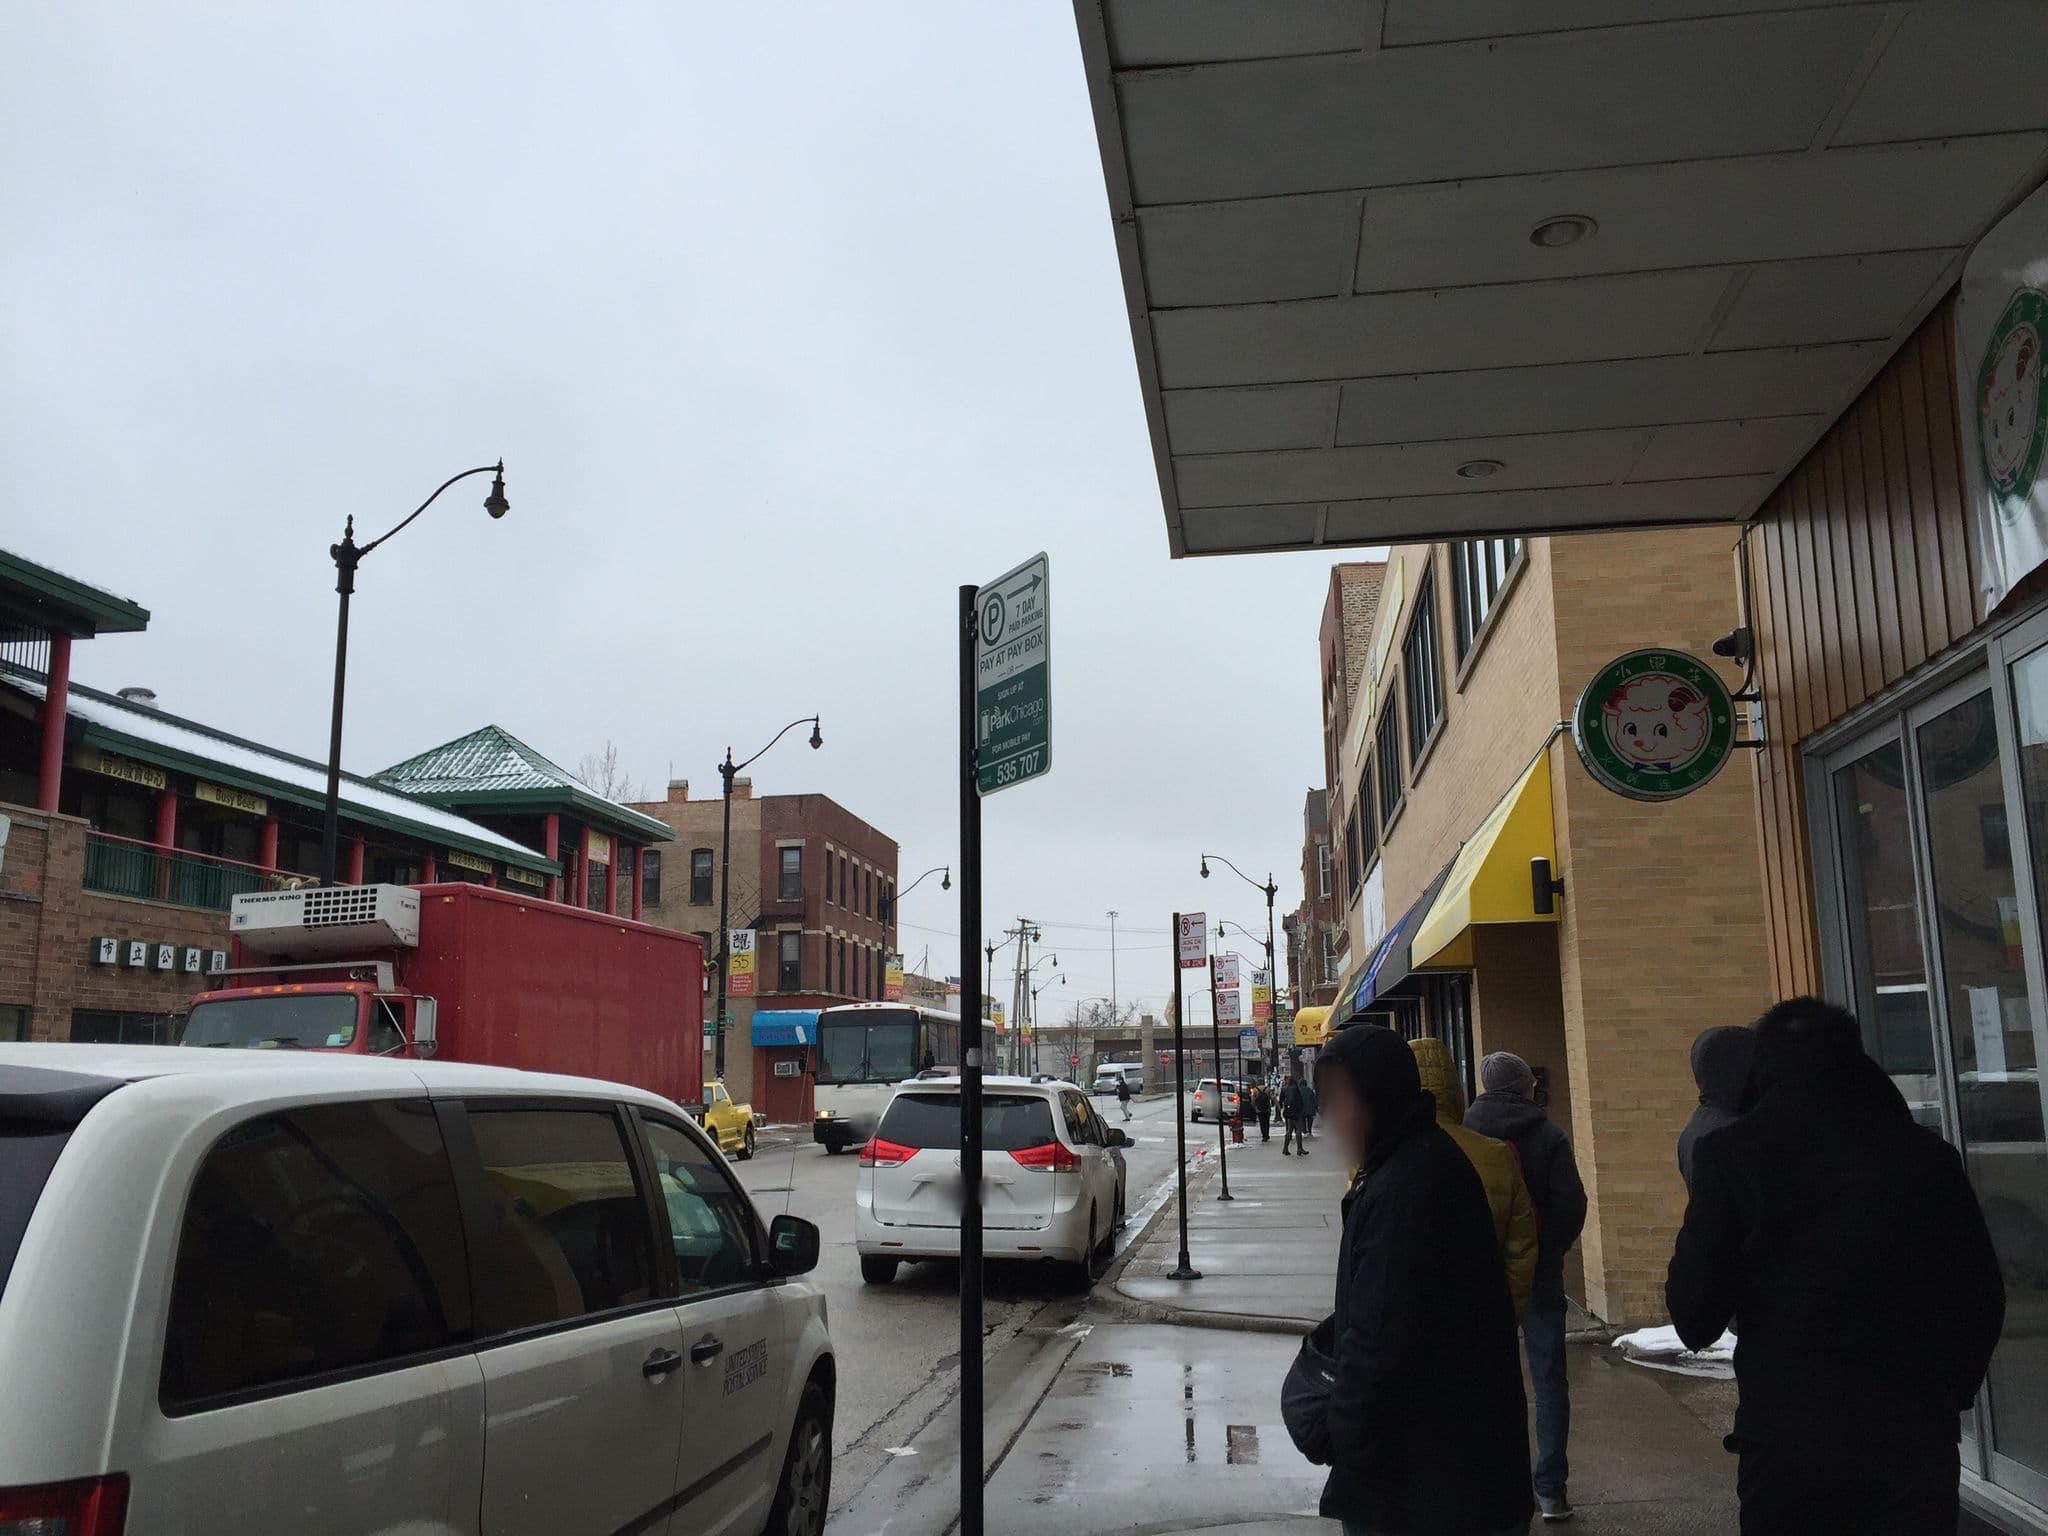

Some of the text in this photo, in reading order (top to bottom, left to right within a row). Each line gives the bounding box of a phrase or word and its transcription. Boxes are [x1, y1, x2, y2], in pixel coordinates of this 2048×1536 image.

[1015, 595, 1036, 619] 7 DAY
[1008, 607, 1044, 634] PAID PARKING
[980, 631, 1044, 675] PAY AT PAY BOX
[990, 698, 1045, 732] ParkChicago
[1002, 736, 1020, 752] MOBILE
[997, 750, 1041, 785] 535 707
[215, 788, 257, 810] Busy Bees
[239, 893, 303, 905] THERMO KING
